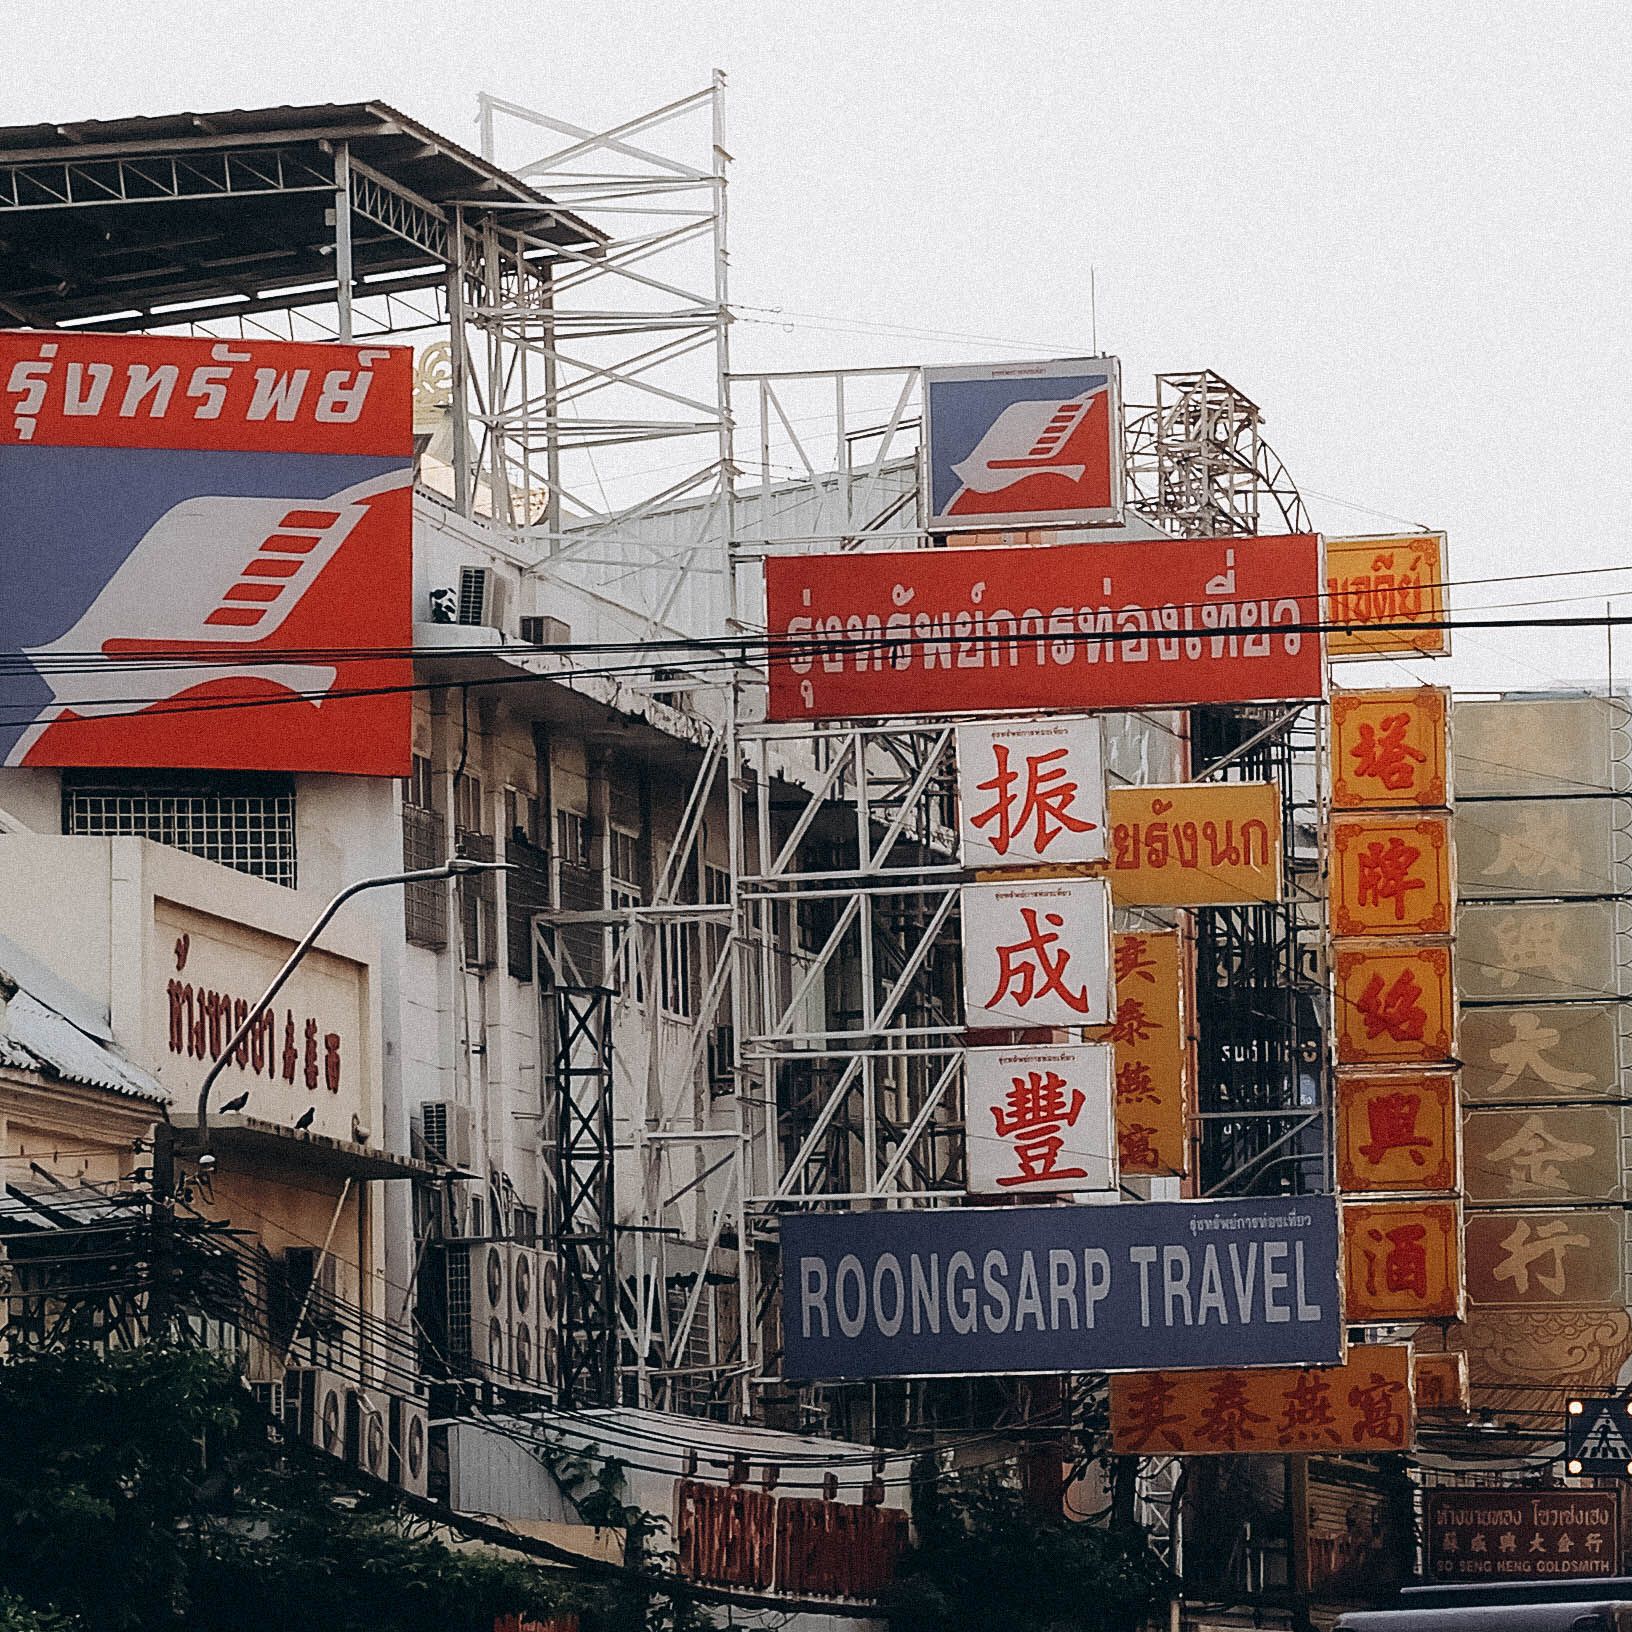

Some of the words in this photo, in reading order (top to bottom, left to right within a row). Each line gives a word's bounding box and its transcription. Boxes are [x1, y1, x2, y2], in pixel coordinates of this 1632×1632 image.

[5, 340, 392, 442] รุ่งทรัพย์
[785, 549, 1303, 708] รุ่งทรัพย์การท่องเที่ยว
[969, 744, 1098, 1188] 振成豐
[800, 1248, 1112, 1339] ROONGSARP
[1129, 1238, 1322, 1328] TRAVEL
[1536, 1560, 1611, 1574] GOLDSMITH
